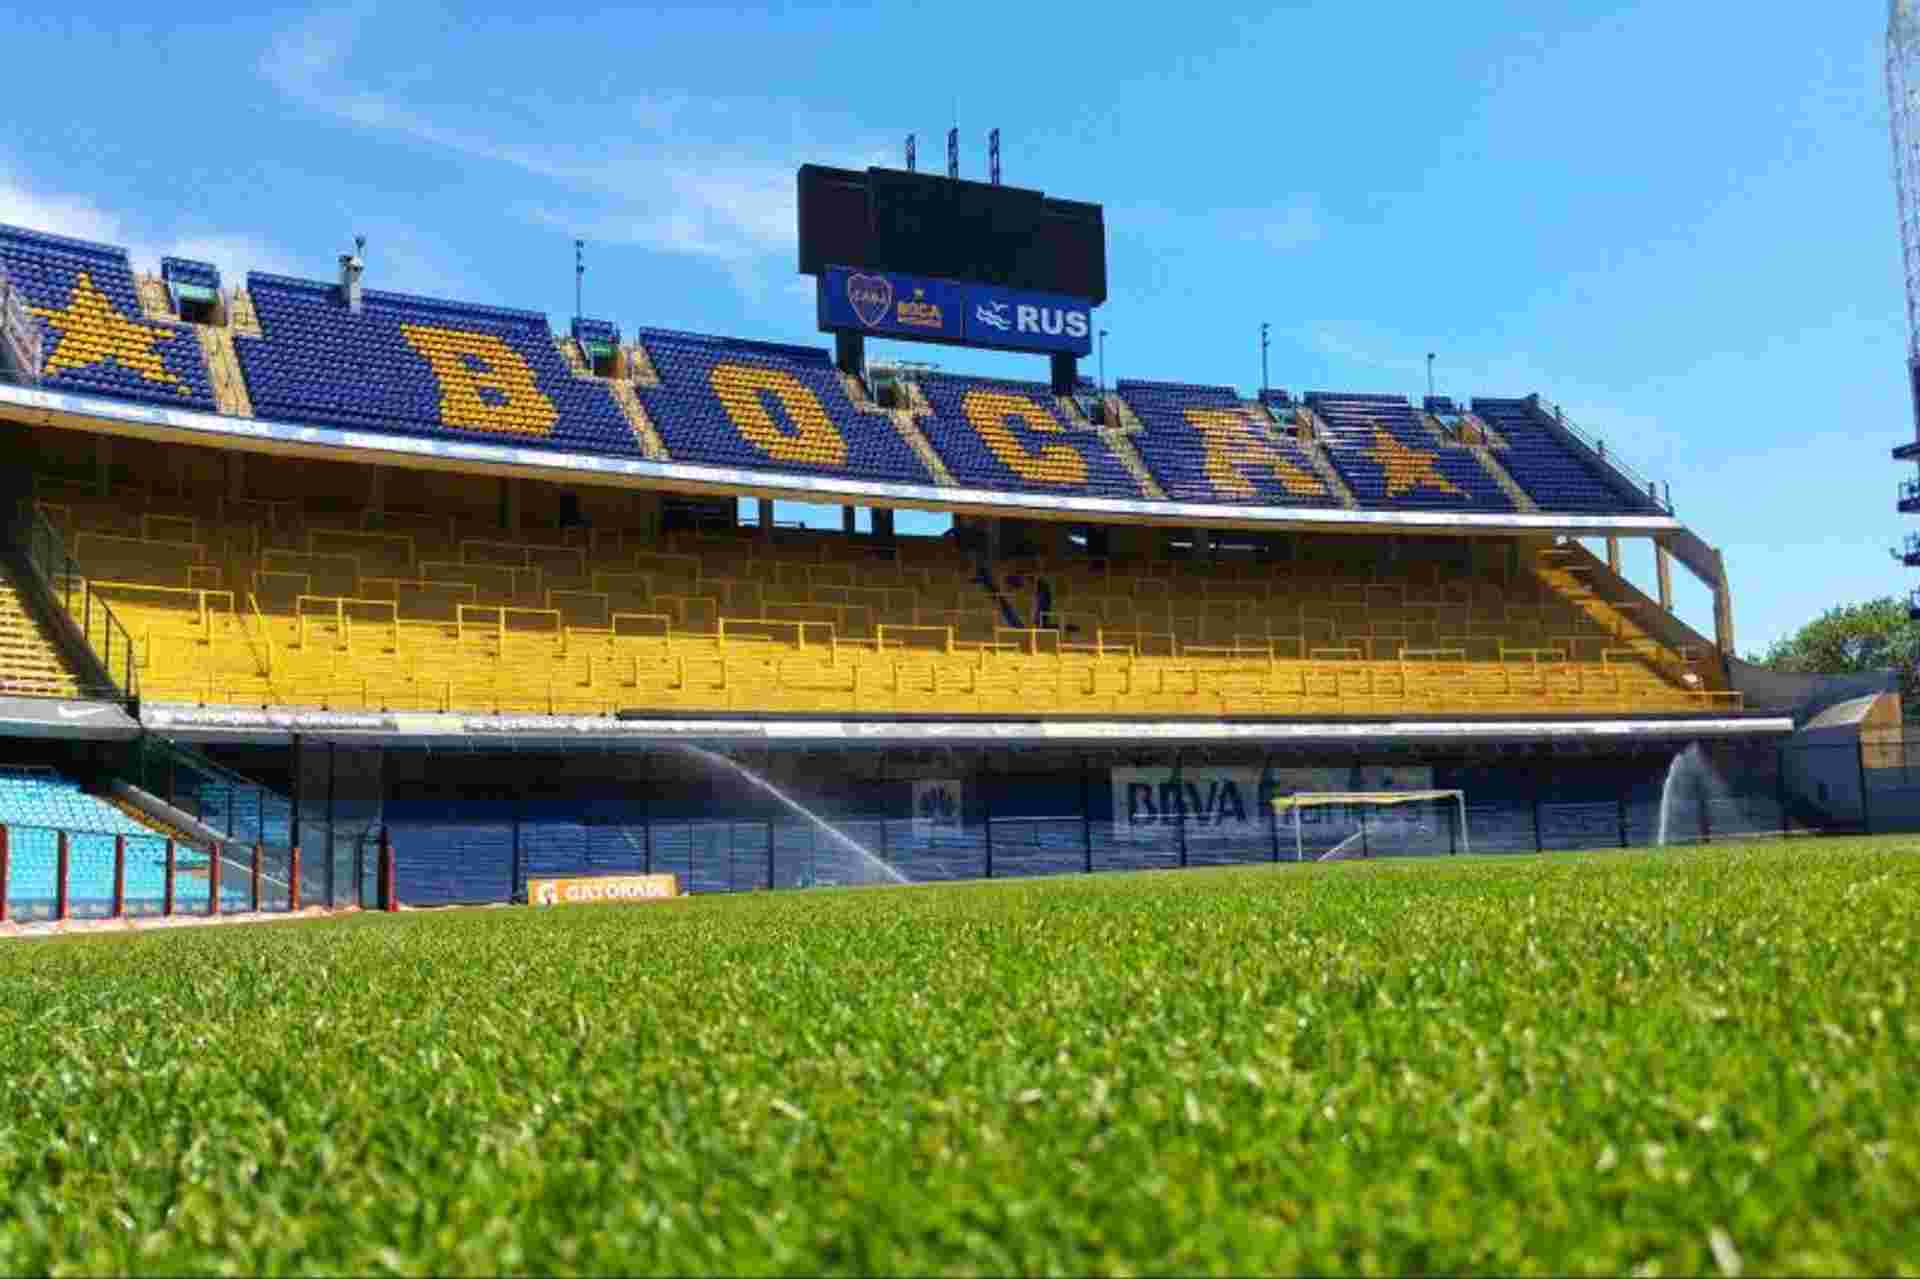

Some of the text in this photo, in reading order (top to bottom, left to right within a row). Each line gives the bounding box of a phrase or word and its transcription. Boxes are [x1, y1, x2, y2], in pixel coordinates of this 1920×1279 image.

[1016, 304, 1088, 338] RUS
[401, 322, 1328, 498] BOCA
[1128, 781, 1249, 825] BBVA
